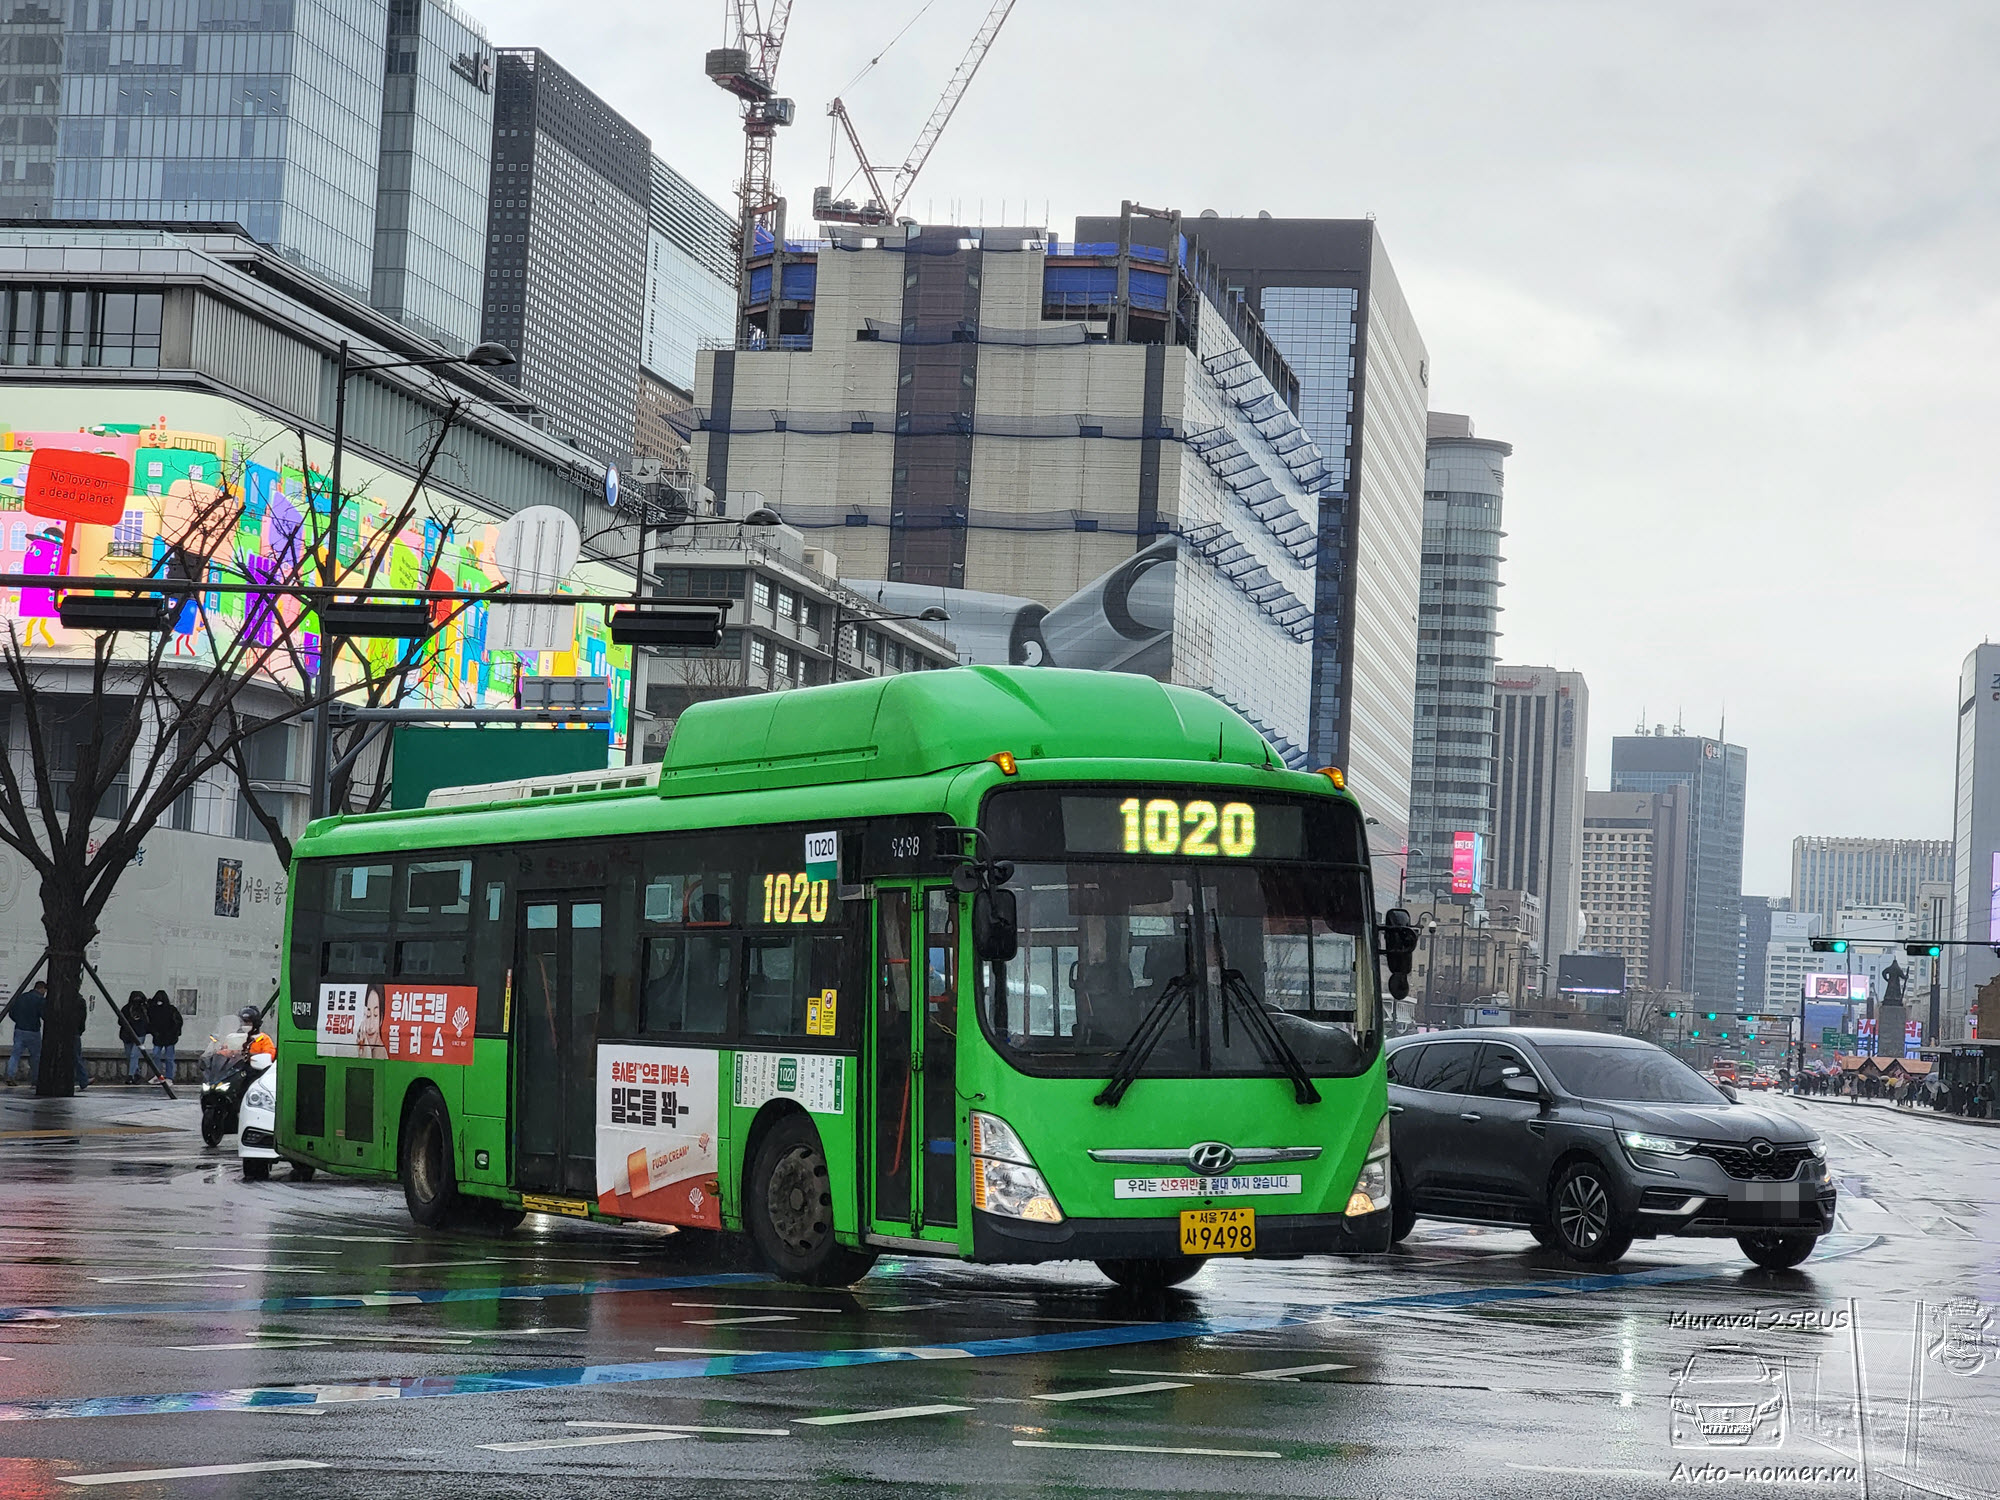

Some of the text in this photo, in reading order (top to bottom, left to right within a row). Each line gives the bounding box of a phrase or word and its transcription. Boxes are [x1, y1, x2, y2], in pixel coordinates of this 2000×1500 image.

[50, 471, 108, 489] No love on
[39, 487, 115, 505] a dead planet
[1119, 798, 1256, 858] 1020
[808, 838, 835, 858] 1020
[891, 836, 920, 858] 9498
[243, 876, 271, 904] 서울의
[763, 872, 829, 923] 1020
[660, 1064, 679, 1087] 피부
[680, 1066, 690, 1087] 속
[779, 1067, 796, 1082] 1020
[611, 1087, 657, 1127] 밀도를
[652, 1157, 668, 1170] FUSID
[1128, 1176, 1290, 1192] 우리는 신호위반을 절대 하지 않습니다.
[1199, 1211, 1238, 1224] 서울 74
